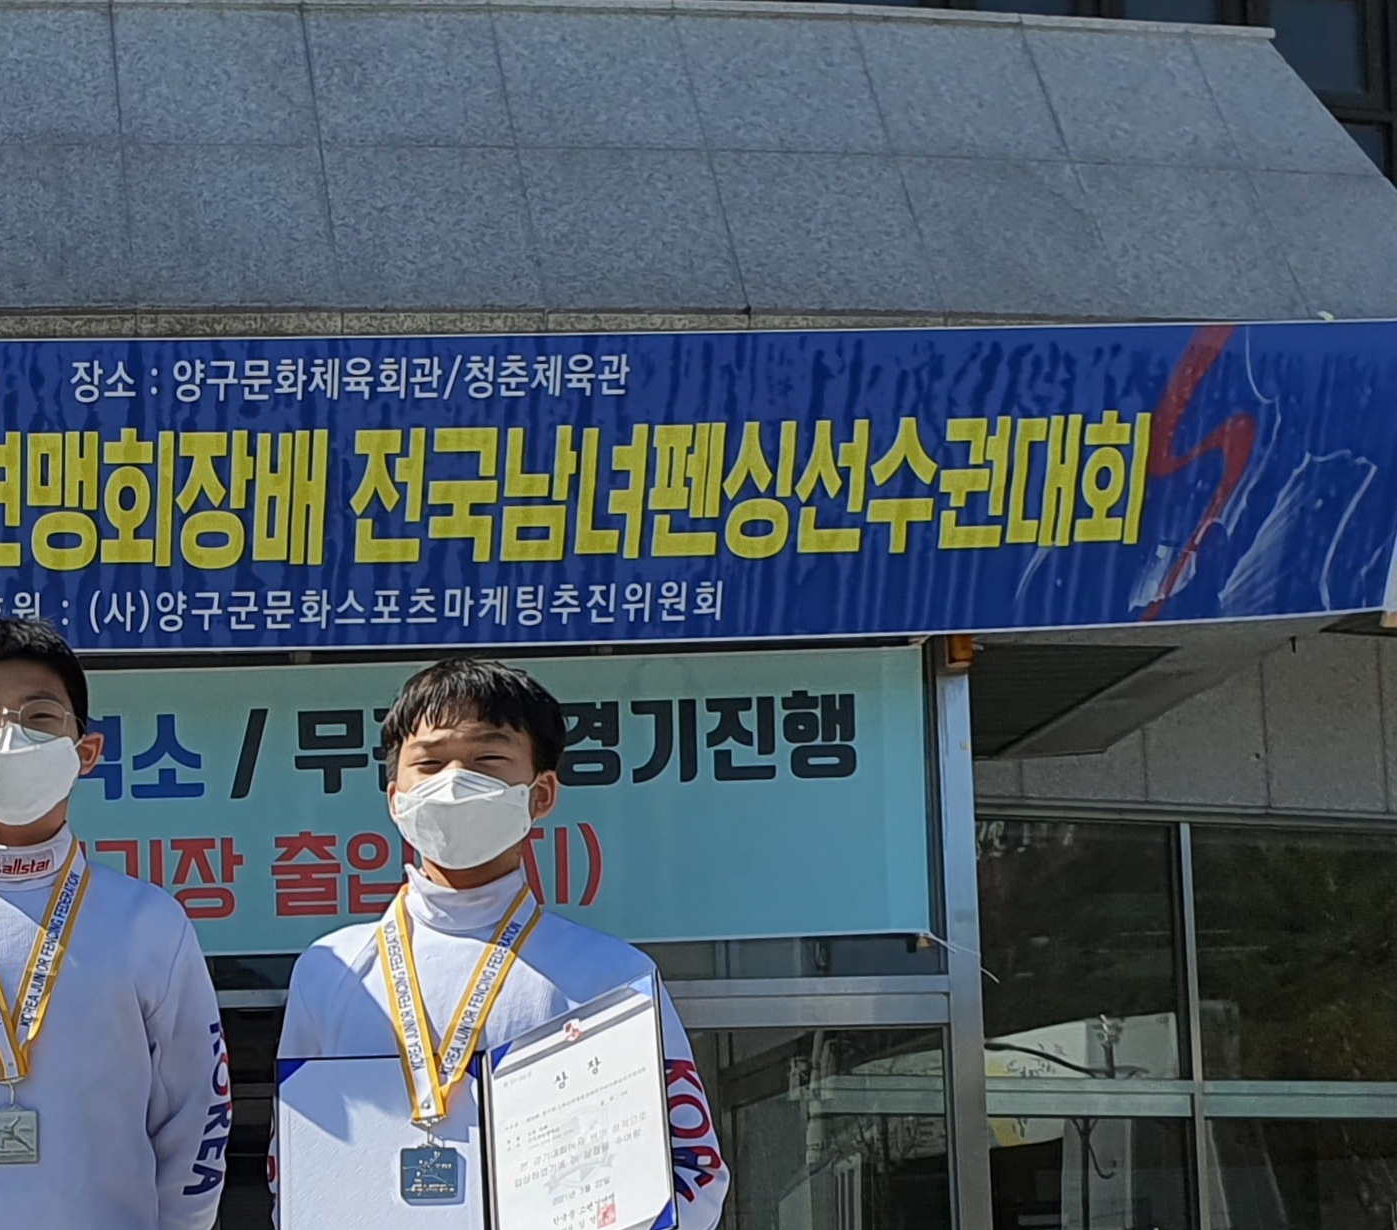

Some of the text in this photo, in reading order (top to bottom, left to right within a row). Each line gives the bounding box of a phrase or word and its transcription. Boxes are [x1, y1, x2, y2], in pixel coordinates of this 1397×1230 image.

[69, 359, 136, 402] 장소
[172, 352, 631, 402] 양구문화체육회관/청춘체육관
[350, 409, 1151, 566] 전국남녀펜싱선수권대회
[89, 580, 724, 633] (사)양구군문화스포츠마케팅추진위원회
[230, 708, 269, 799] /
[558, 689, 857, 786] 경기진행
[3, 858, 50, 874] allstar
[81, 836, 244, 919] 기장
[270, 822, 602, 917] 출입지)
[19, 994, 40, 1027] KOREA
[32, 958, 51, 995] JUNIOR
[440, 921, 522, 1076] KOREA JUNIOR FENCING FEDERATION
[408, 1042, 426, 1071] KOREA
